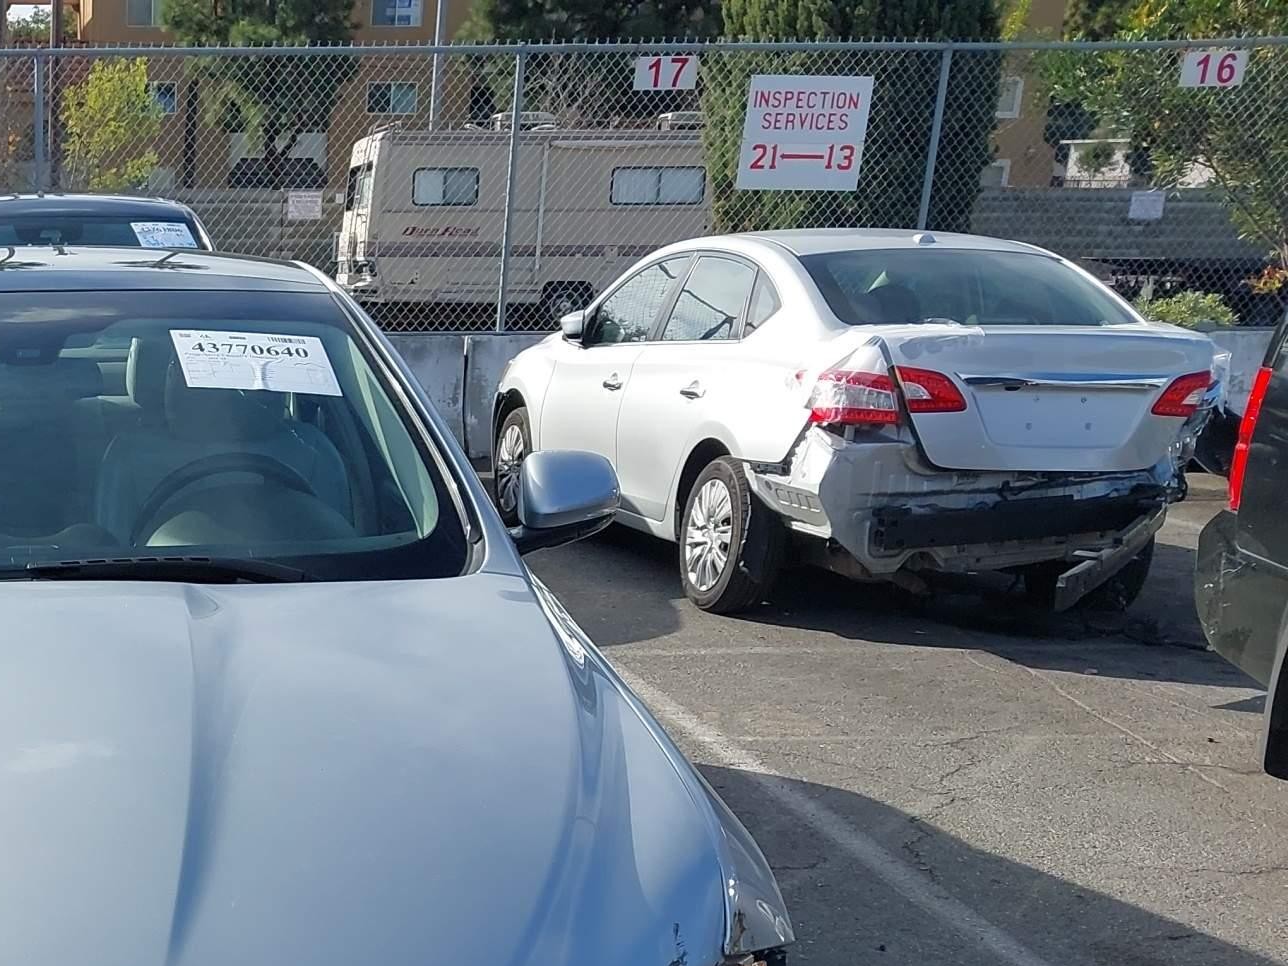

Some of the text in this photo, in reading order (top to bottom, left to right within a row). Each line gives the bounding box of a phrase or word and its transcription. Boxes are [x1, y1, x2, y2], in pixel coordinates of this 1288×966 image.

[648, 58, 689, 88] 17
[1196, 53, 1237, 84] 16
[753, 90, 860, 110] INSPECTION
[761, 112, 849, 130] SERVICES
[749, 144, 855, 171] 21 13
[191, 341, 309, 359] 43770640
